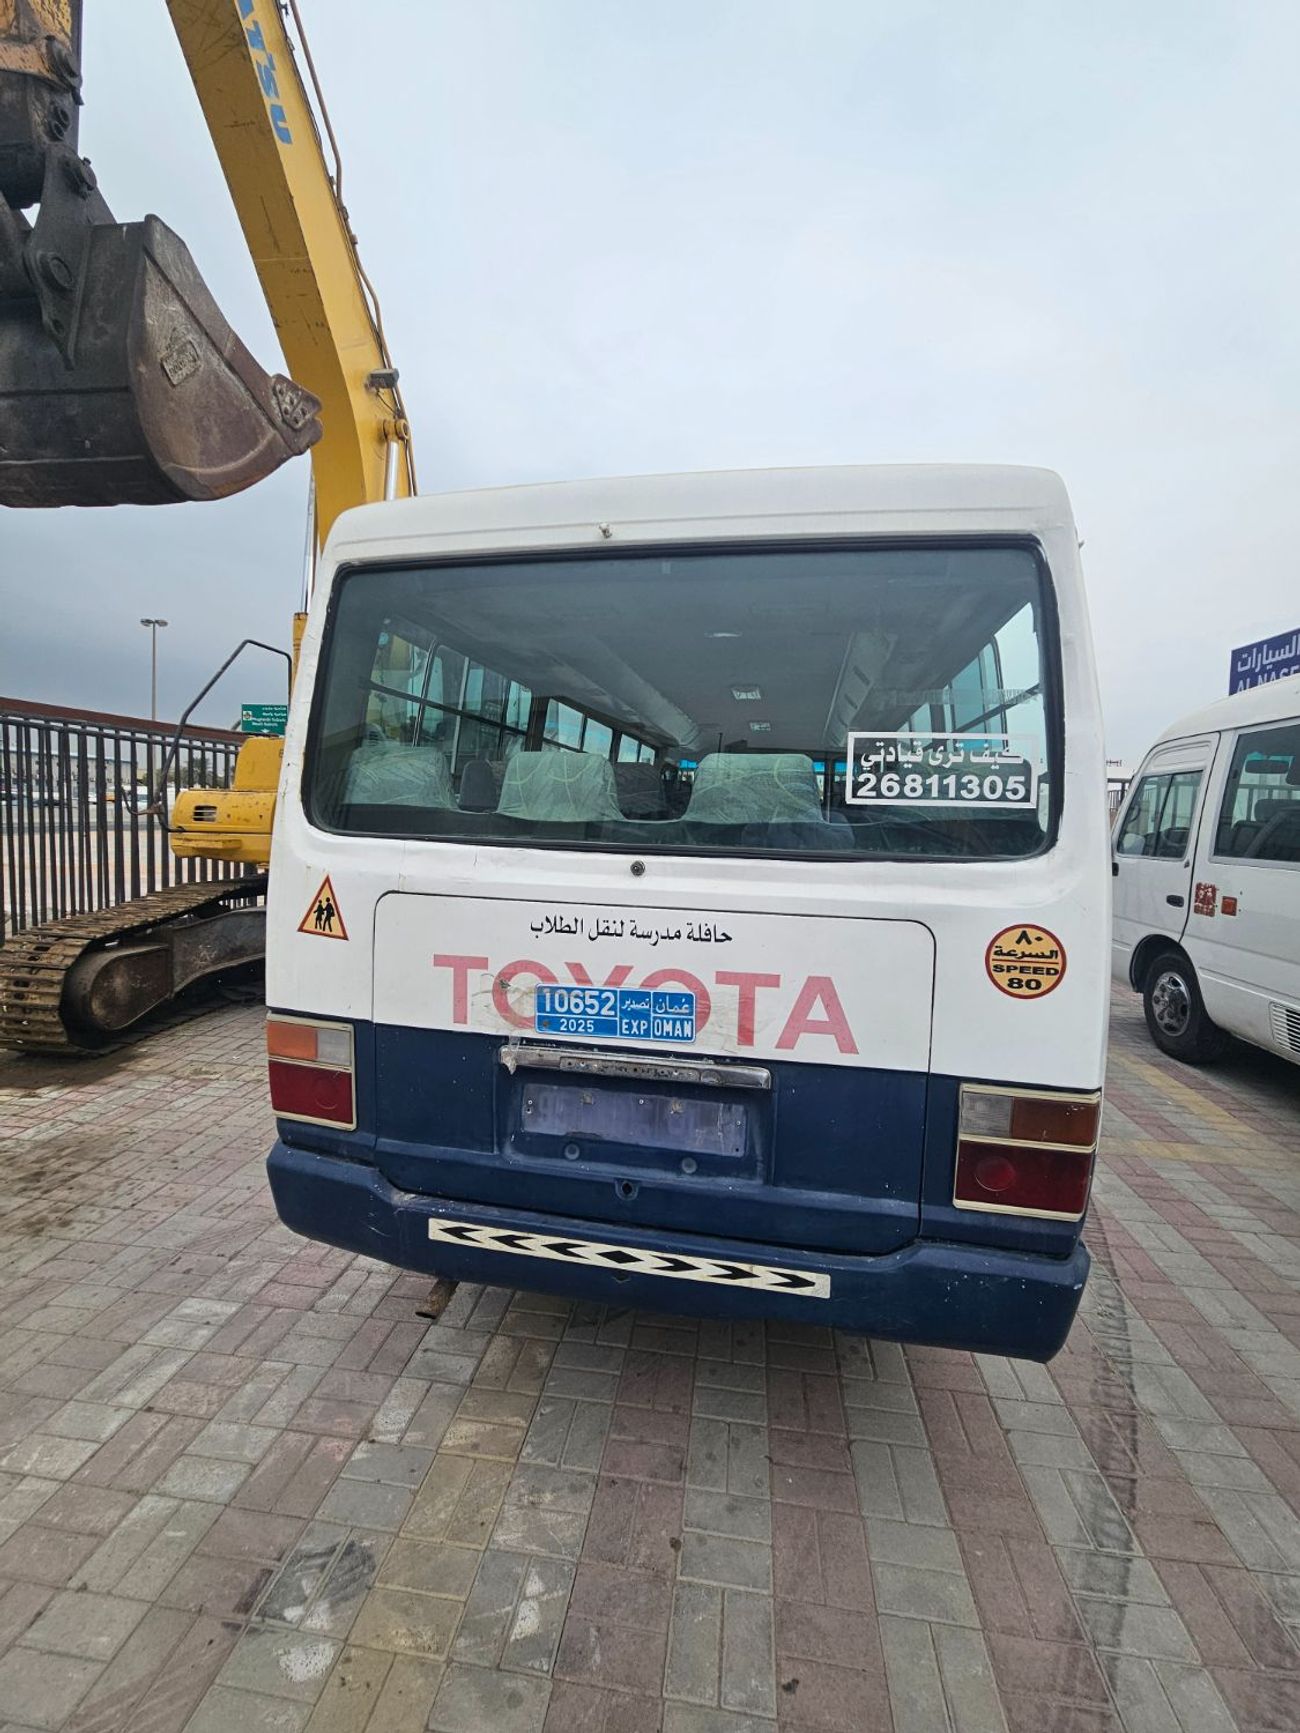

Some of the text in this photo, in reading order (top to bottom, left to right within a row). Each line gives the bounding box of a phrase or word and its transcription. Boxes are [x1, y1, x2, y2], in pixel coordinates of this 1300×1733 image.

[1237, 632, 1300, 672] السيارات
[861, 740, 1024, 771] كيف ترى قيادتي
[856, 773, 1026, 800] 26811305
[530, 915, 733, 946] حافلة مدرسة لنقل الطلاب
[993, 945, 1059, 960] السرعة
[992, 964, 1060, 976] SPEED
[1007, 977, 1042, 990] 80
[543, 988, 615, 1016] 10652
[621, 997, 651, 1011] تصدير
[560, 1019, 595, 1033] 2025
[622, 1019, 649, 1035] EXP
[653, 1019, 692, 1038] OMAN
